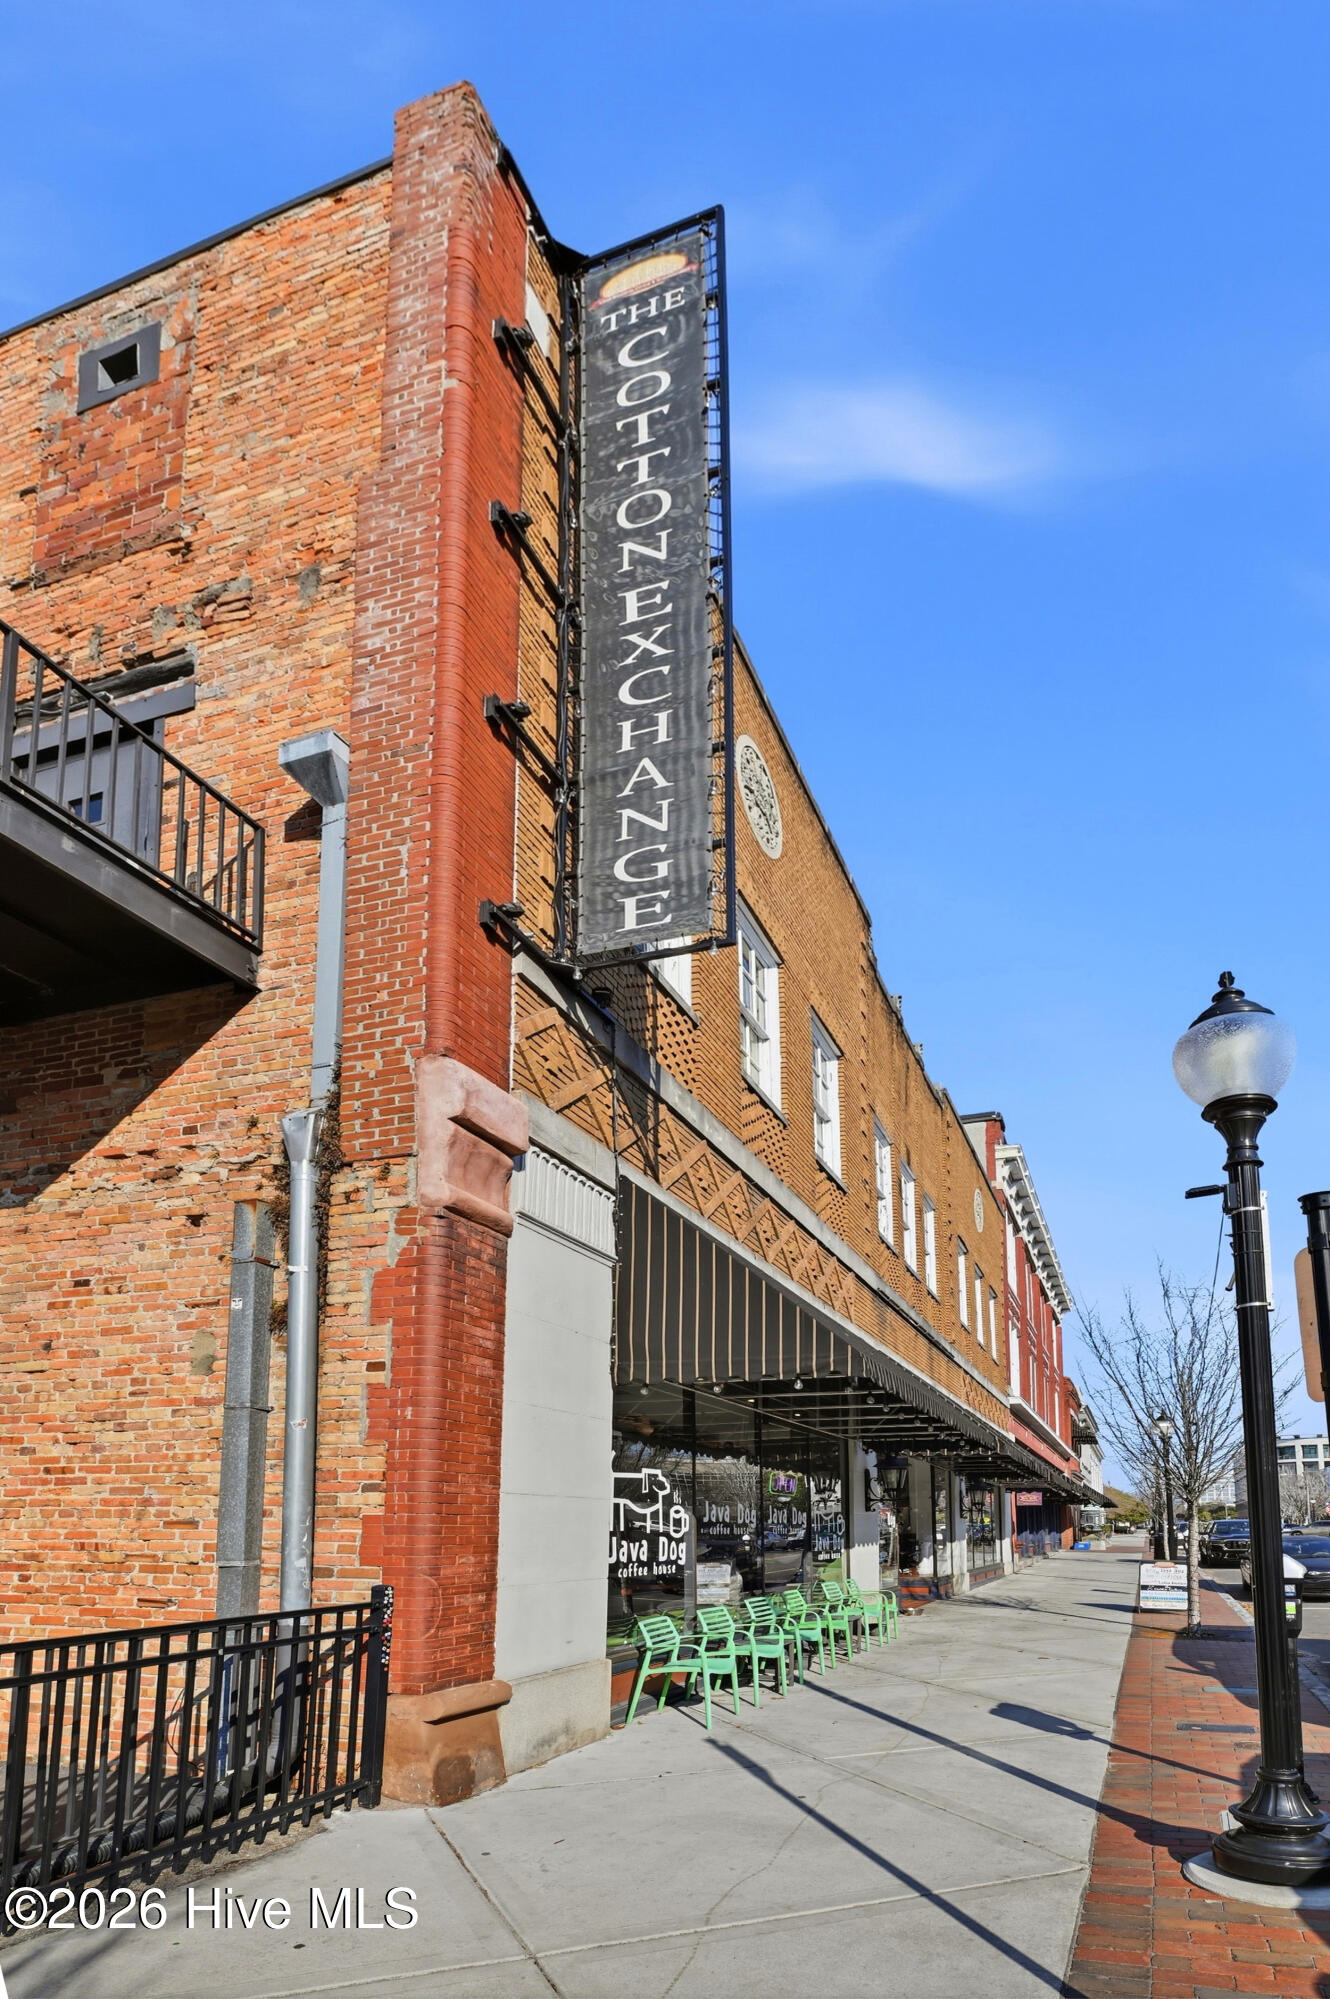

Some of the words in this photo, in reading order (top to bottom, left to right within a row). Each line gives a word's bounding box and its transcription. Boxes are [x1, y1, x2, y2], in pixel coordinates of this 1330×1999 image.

[601, 286, 686, 333] THE
[616, 326, 673, 574] COTTON
[613, 579, 675, 933] EXCHANGE
[703, 1500, 730, 1523] Java
[737, 1503, 757, 1528] Dog
[768, 1505, 787, 1523] Java
[792, 1506, 807, 1528] Dog
[709, 1524, 730, 1535] coffee
[609, 1536, 648, 1564] Java
[659, 1536, 687, 1565] Dog
[618, 1563, 648, 1578] coffee
[653, 1562, 676, 1576] house
